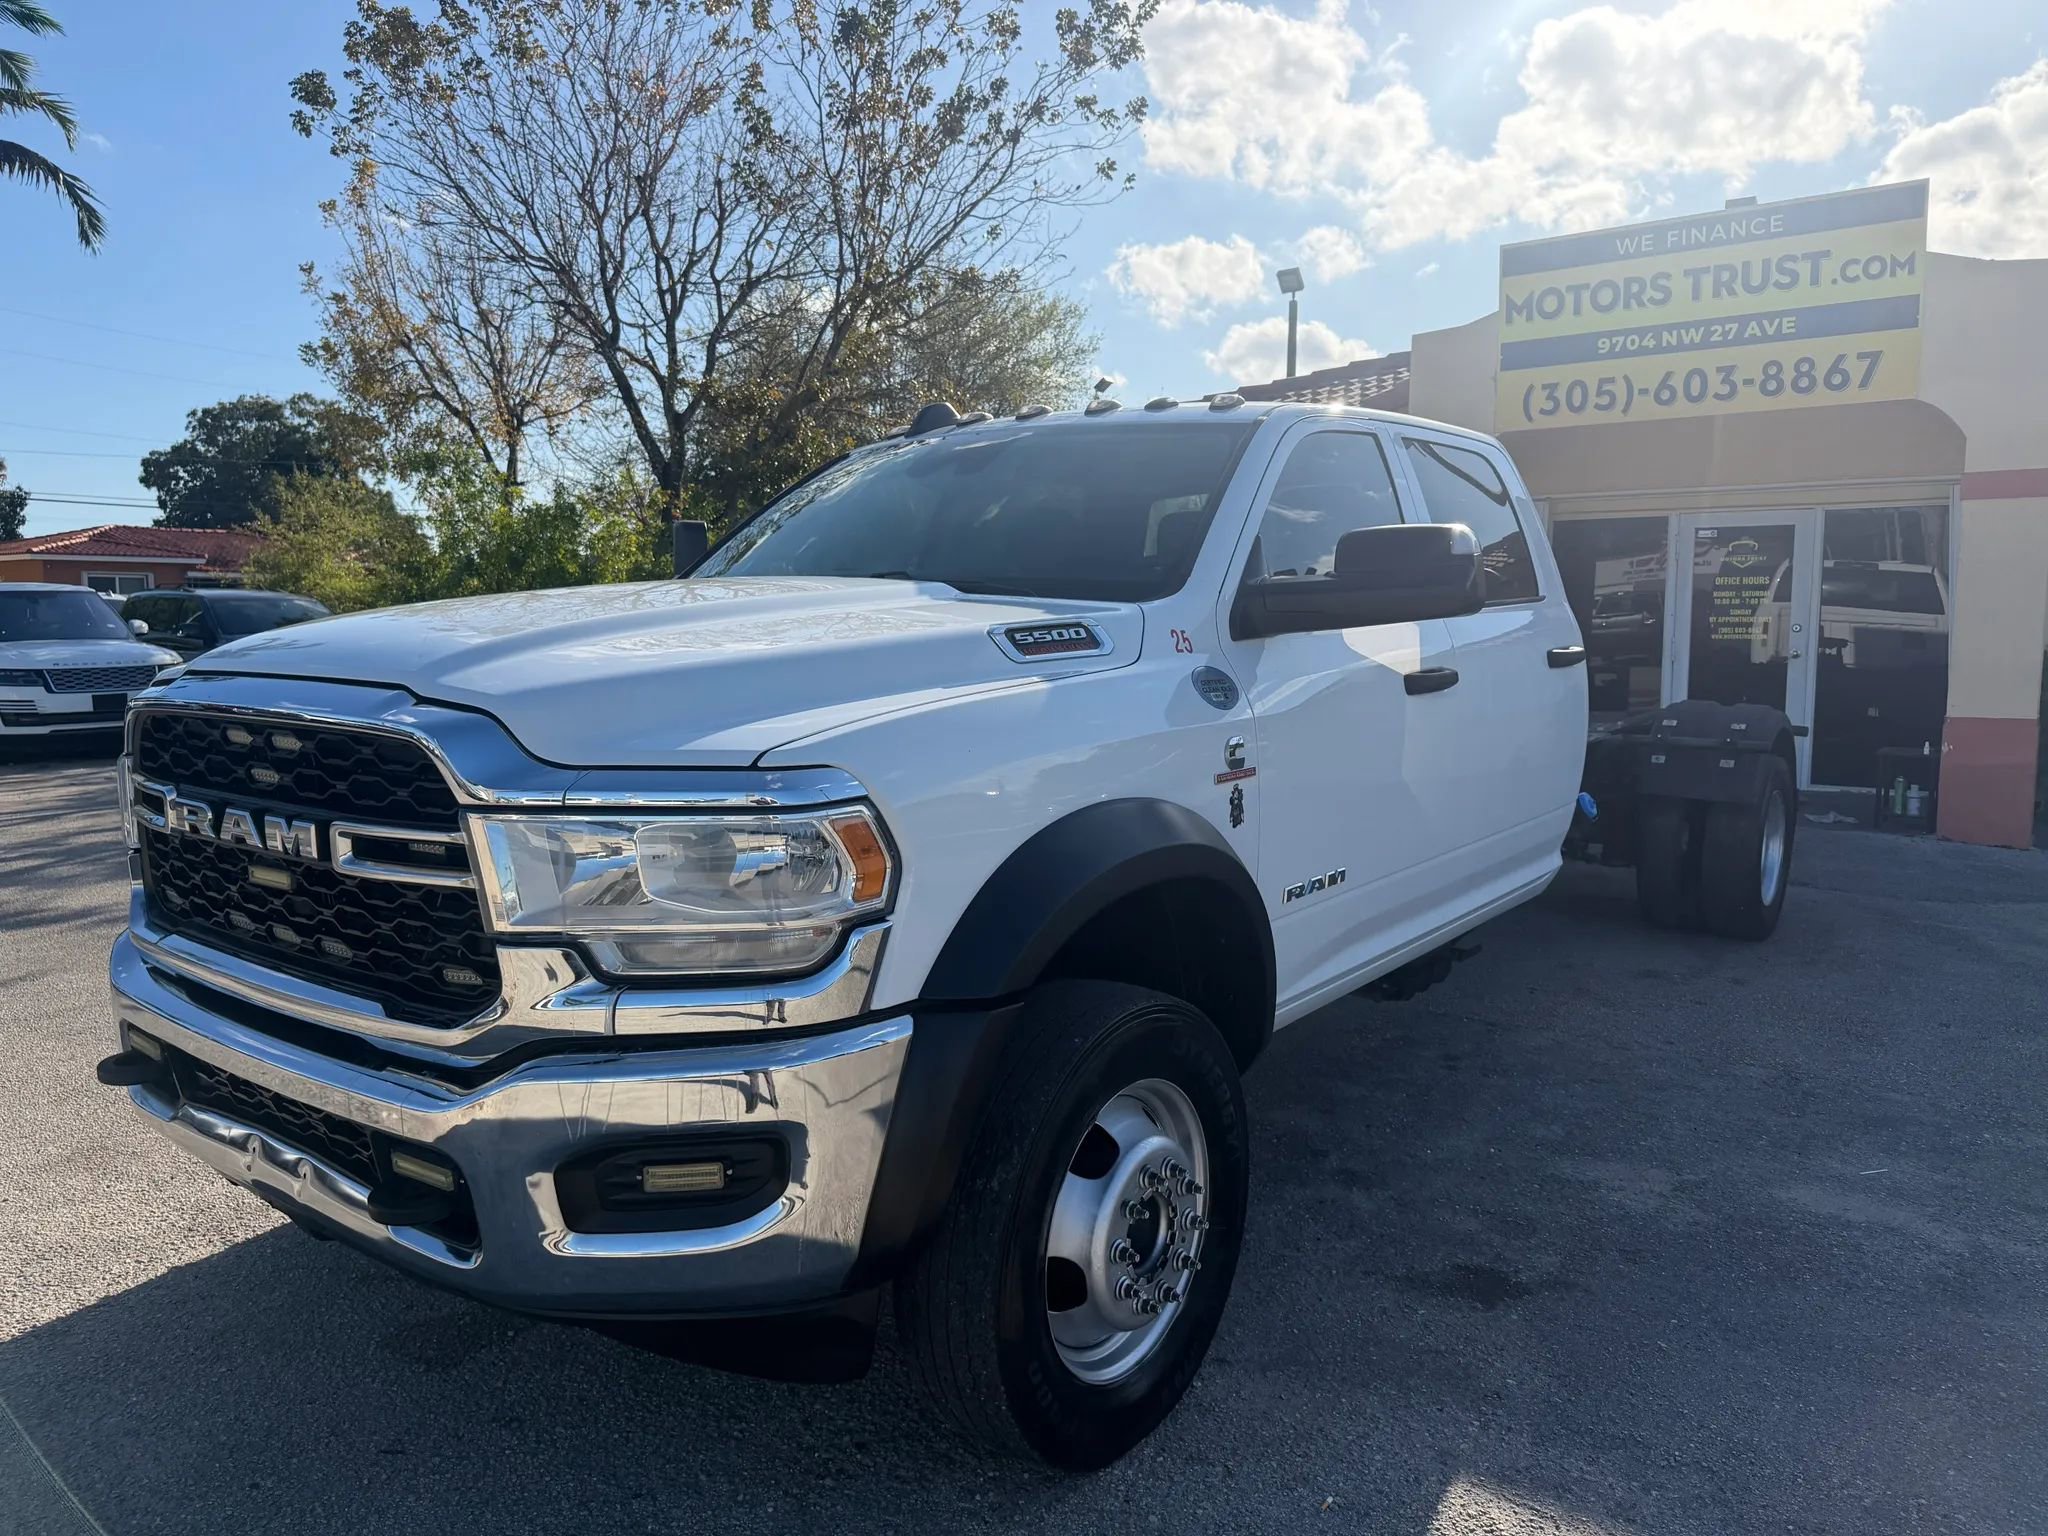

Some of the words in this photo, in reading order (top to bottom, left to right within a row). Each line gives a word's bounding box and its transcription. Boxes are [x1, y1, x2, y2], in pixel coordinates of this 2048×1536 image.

[1616, 234, 1654, 255] WE
[1667, 214, 1785, 246] FINANCE
[1505, 271, 1673, 325] MOTORS
[1682, 249, 1917, 302] TRUST.COM
[1597, 334, 1657, 355] 9704
[1661, 327, 1704, 348] NW
[1709, 323, 1740, 342] 27
[1743, 315, 1797, 338] AVE
[1521, 349, 1884, 423] (305)-603-8867
[1715, 576, 1741, 585] OFFICE
[1742, 576, 1770, 585] HOURS
[1014, 627, 1087, 644] 5500
[1170, 629, 1193, 654] 25
[170, 798, 318, 860] RAM
[1282, 867, 1346, 905] RAM
